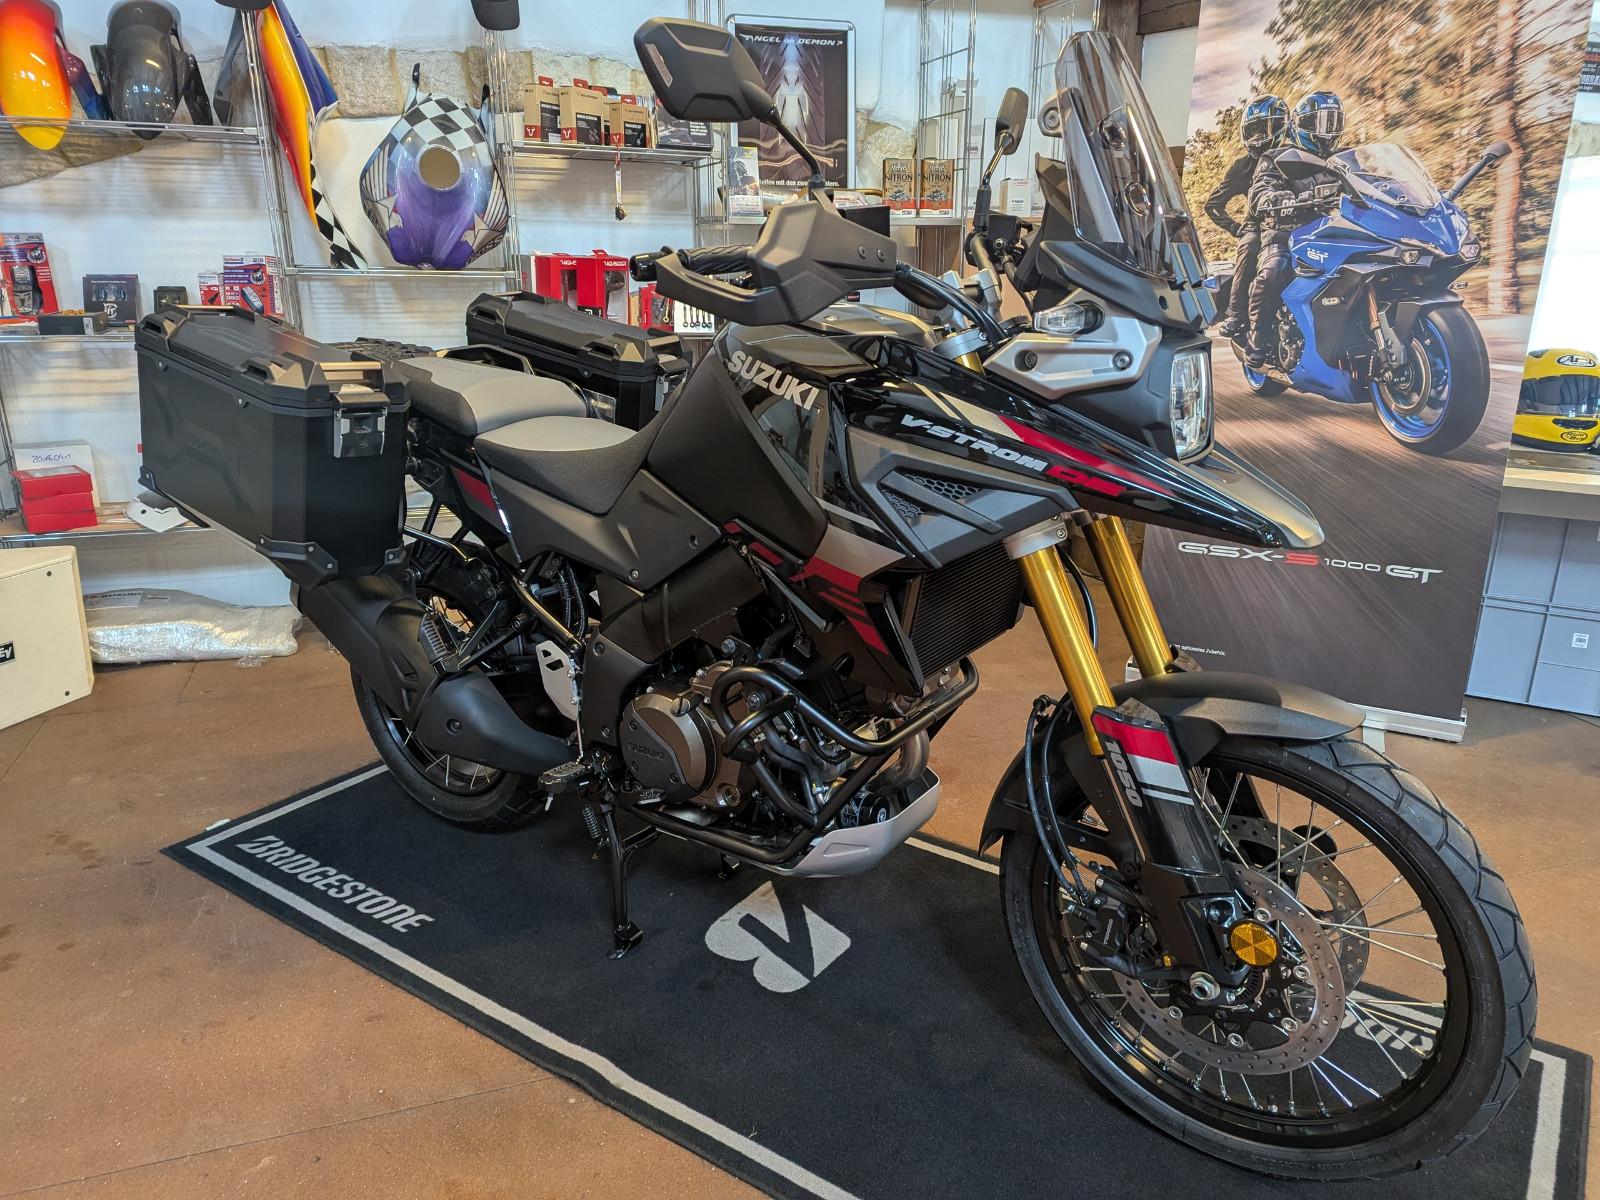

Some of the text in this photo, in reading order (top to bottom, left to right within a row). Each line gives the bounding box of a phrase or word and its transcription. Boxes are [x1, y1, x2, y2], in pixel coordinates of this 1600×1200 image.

[884, 173, 912, 182] NITRON
[923, 173, 951, 182] NITRON
[727, 350, 820, 411] SUZUKI
[900, 413, 1127, 498] V-STROM DE
[1177, 541, 1444, 584] GSX-S 1000 GT
[1104, 740, 1143, 808] 1050
[235, 835, 435, 933] BRIDGESTONE
